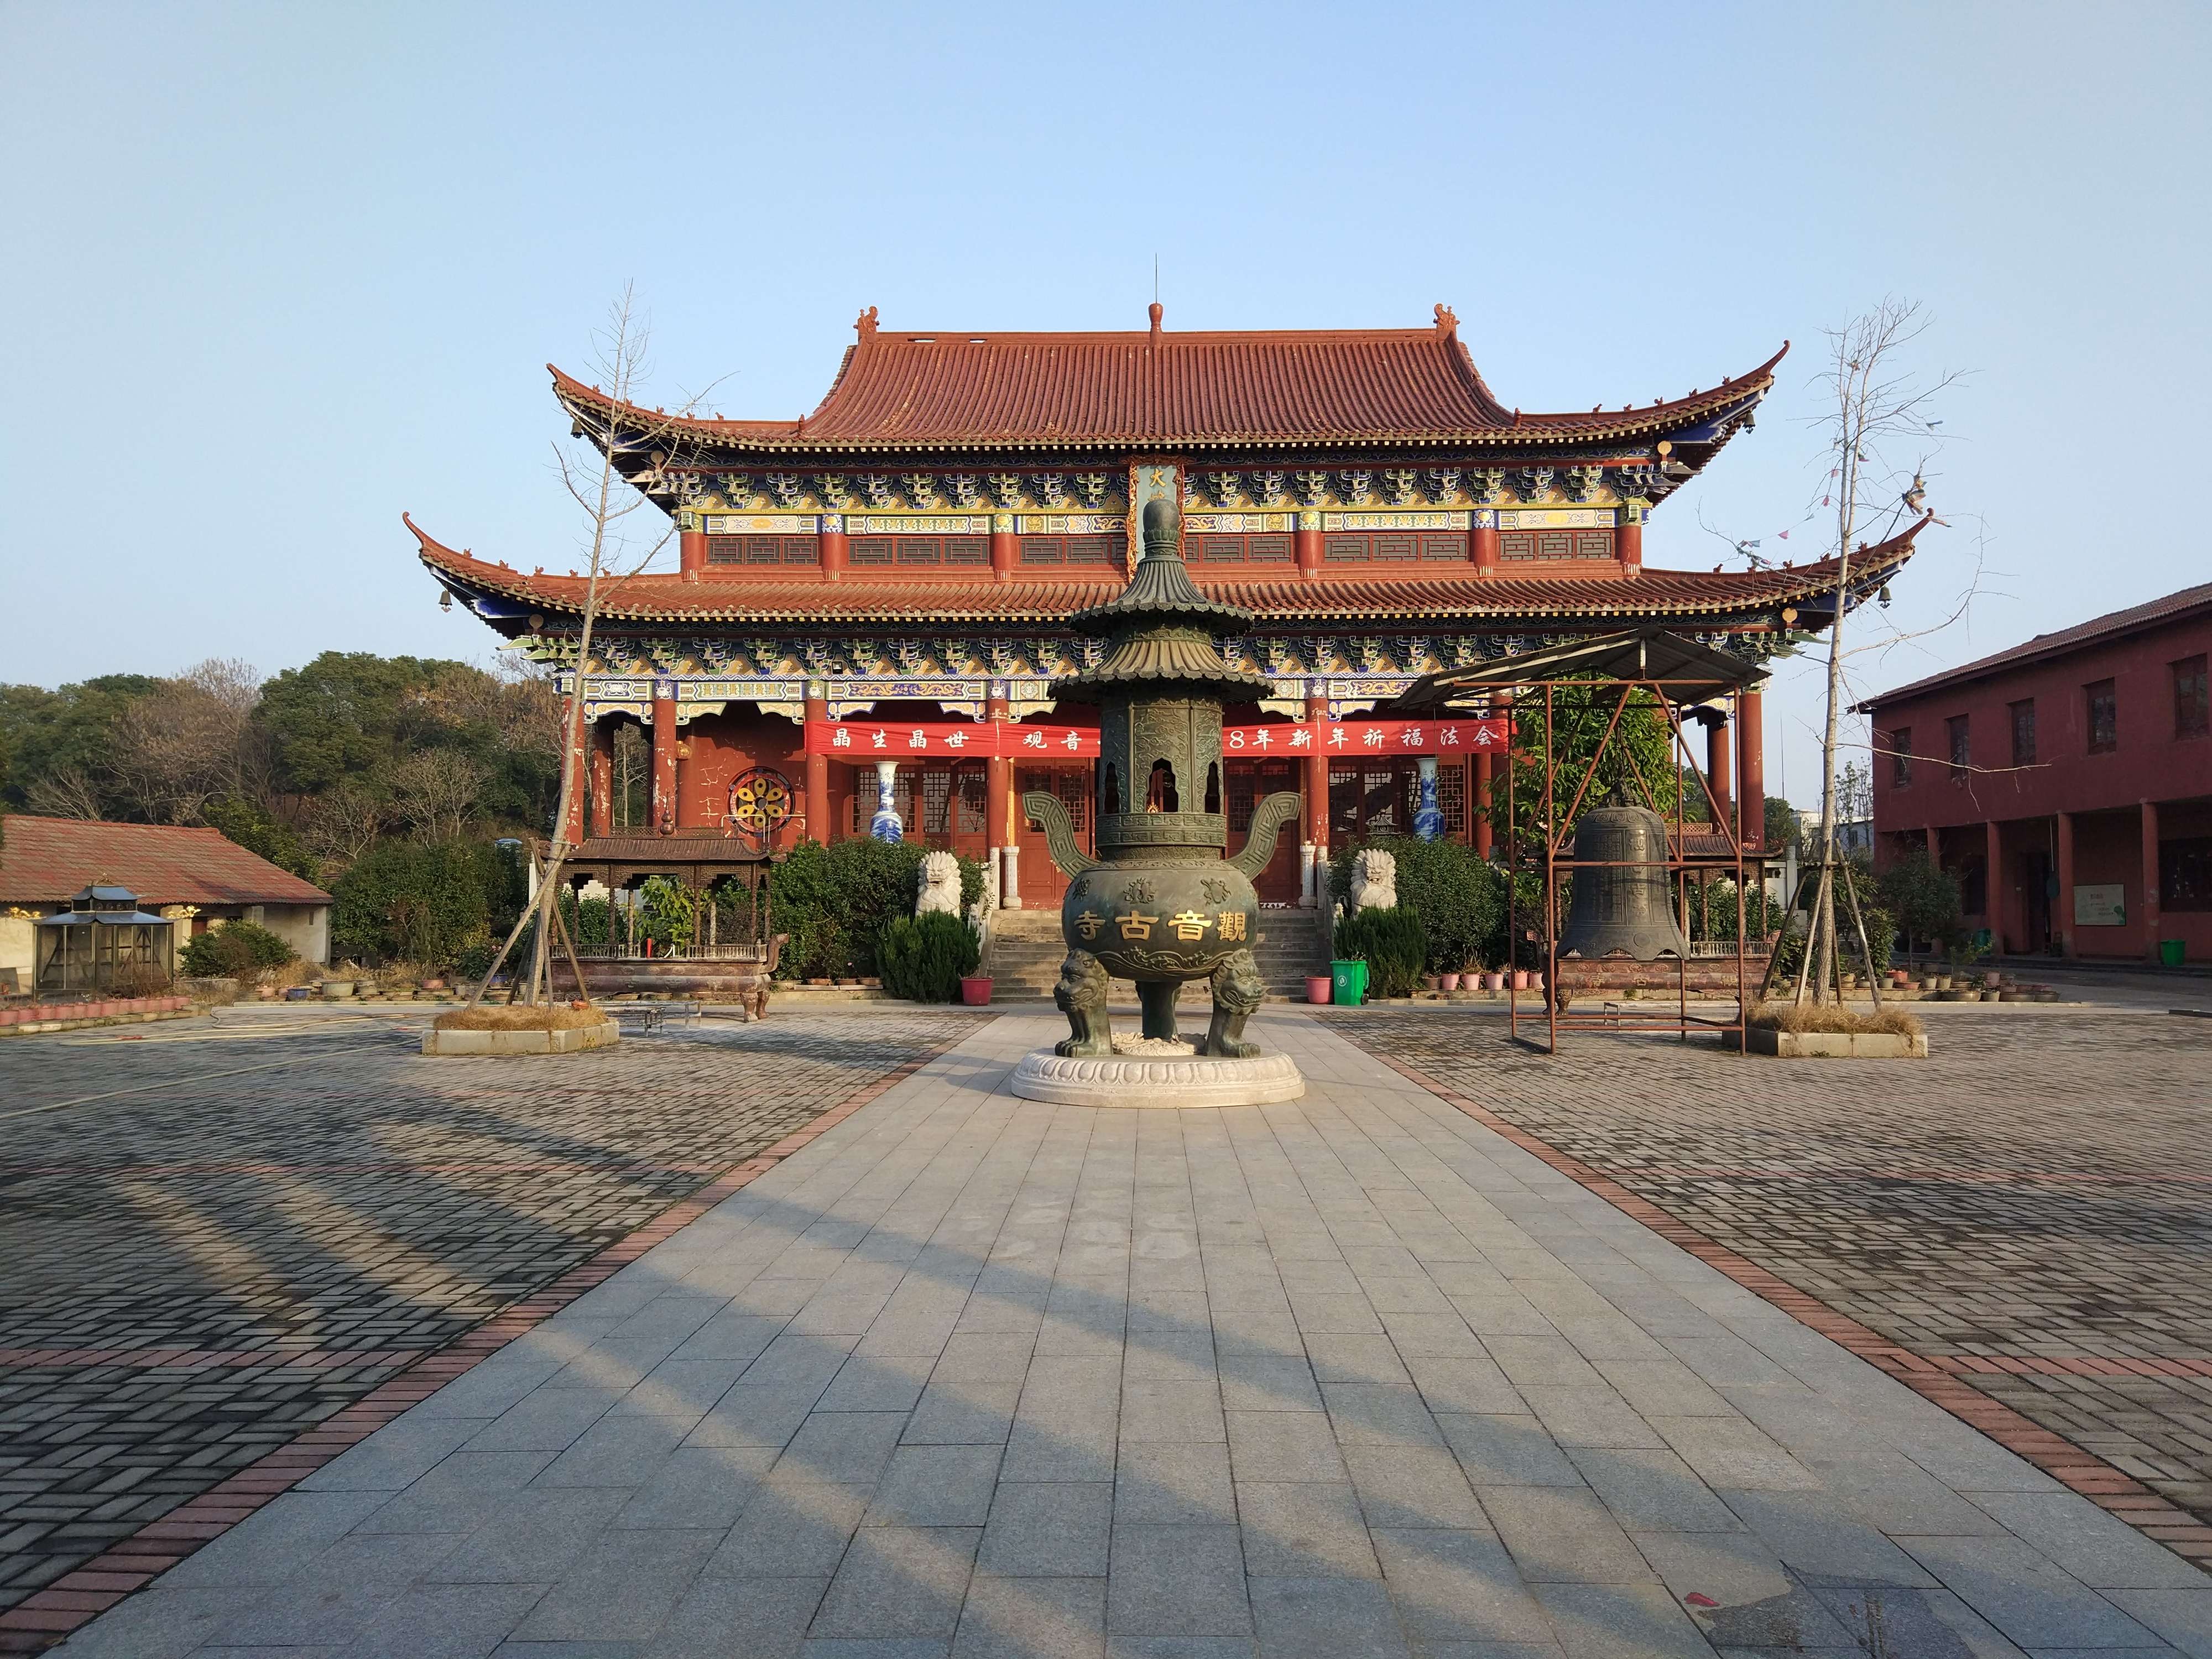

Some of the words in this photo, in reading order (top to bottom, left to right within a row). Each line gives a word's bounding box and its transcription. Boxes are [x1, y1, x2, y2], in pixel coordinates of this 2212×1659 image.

[832, 729, 969, 748] 晶生晶世
[1022, 731, 1100, 751] 观音
